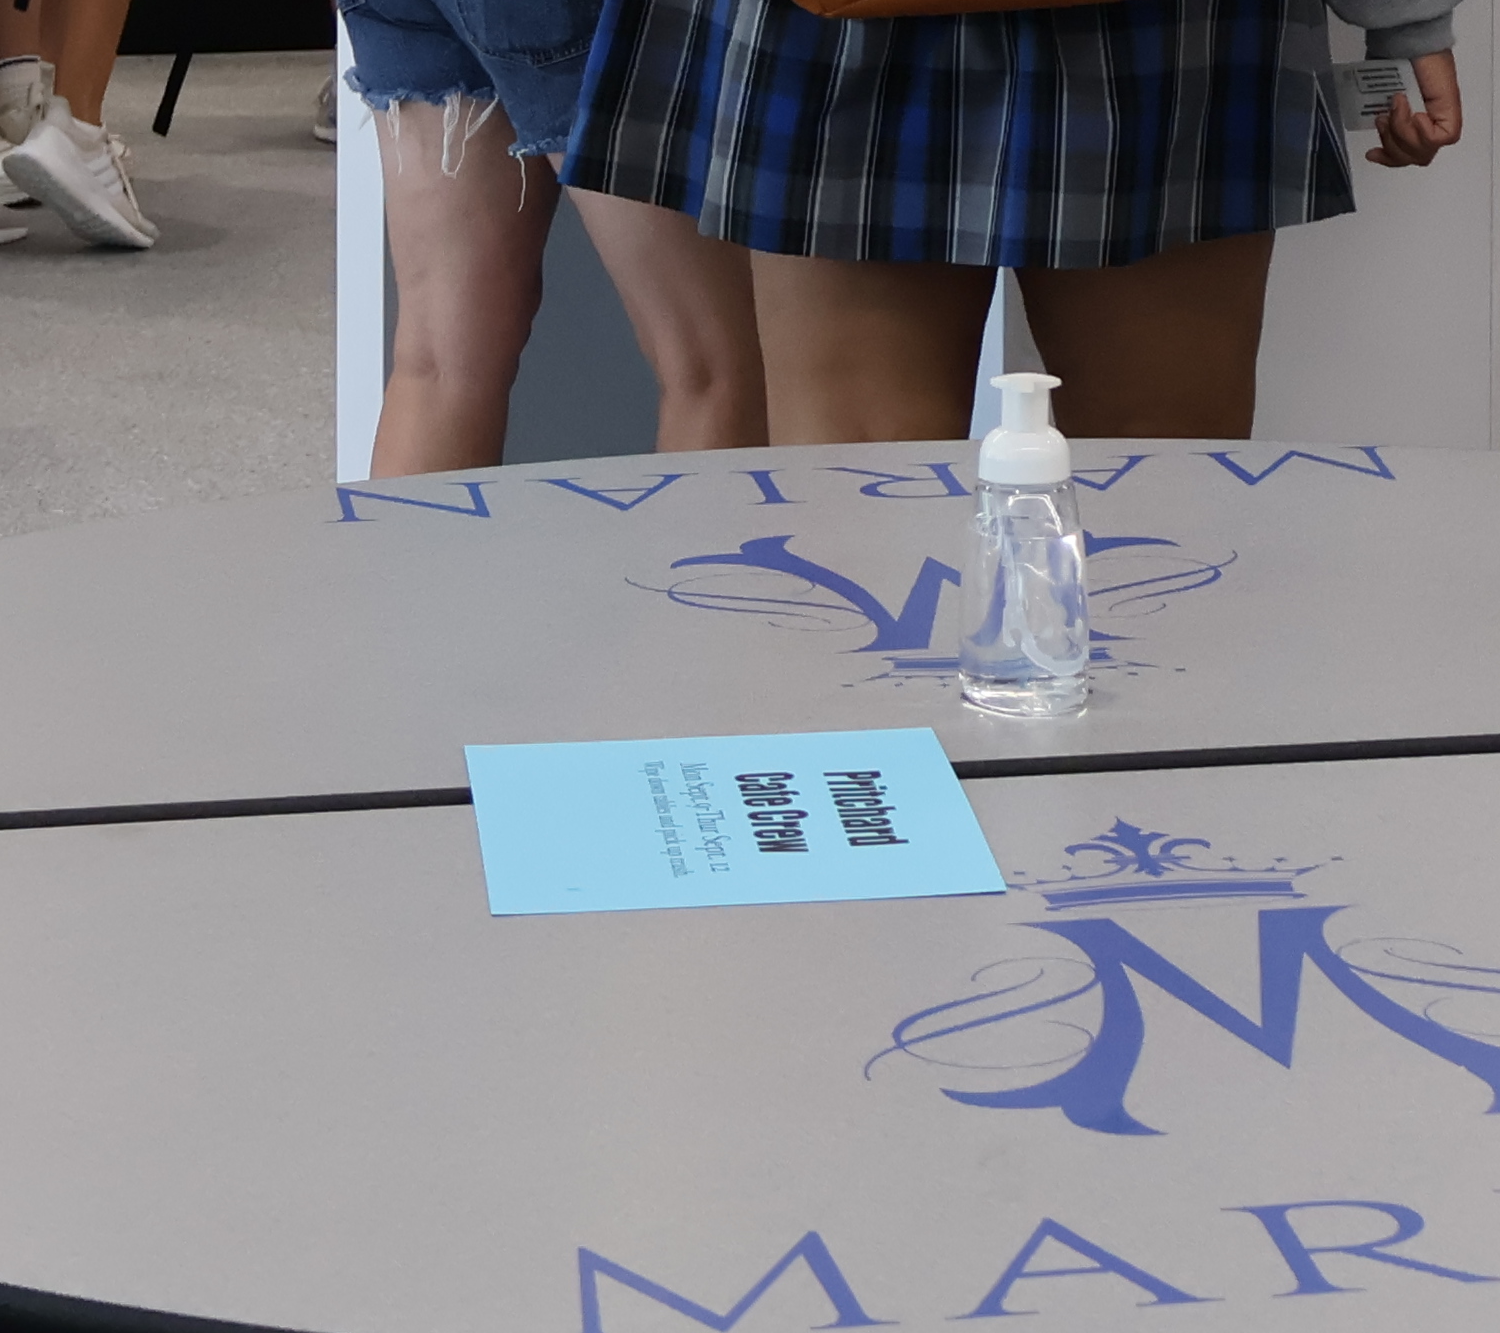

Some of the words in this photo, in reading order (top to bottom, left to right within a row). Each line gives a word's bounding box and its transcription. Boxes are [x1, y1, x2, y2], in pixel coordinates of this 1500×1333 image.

[680, 763, 709, 781] Mon
[734, 772, 800, 807] Cafe
[823, 770, 910, 847] Pritchard
[747, 809, 809, 853] Crew
